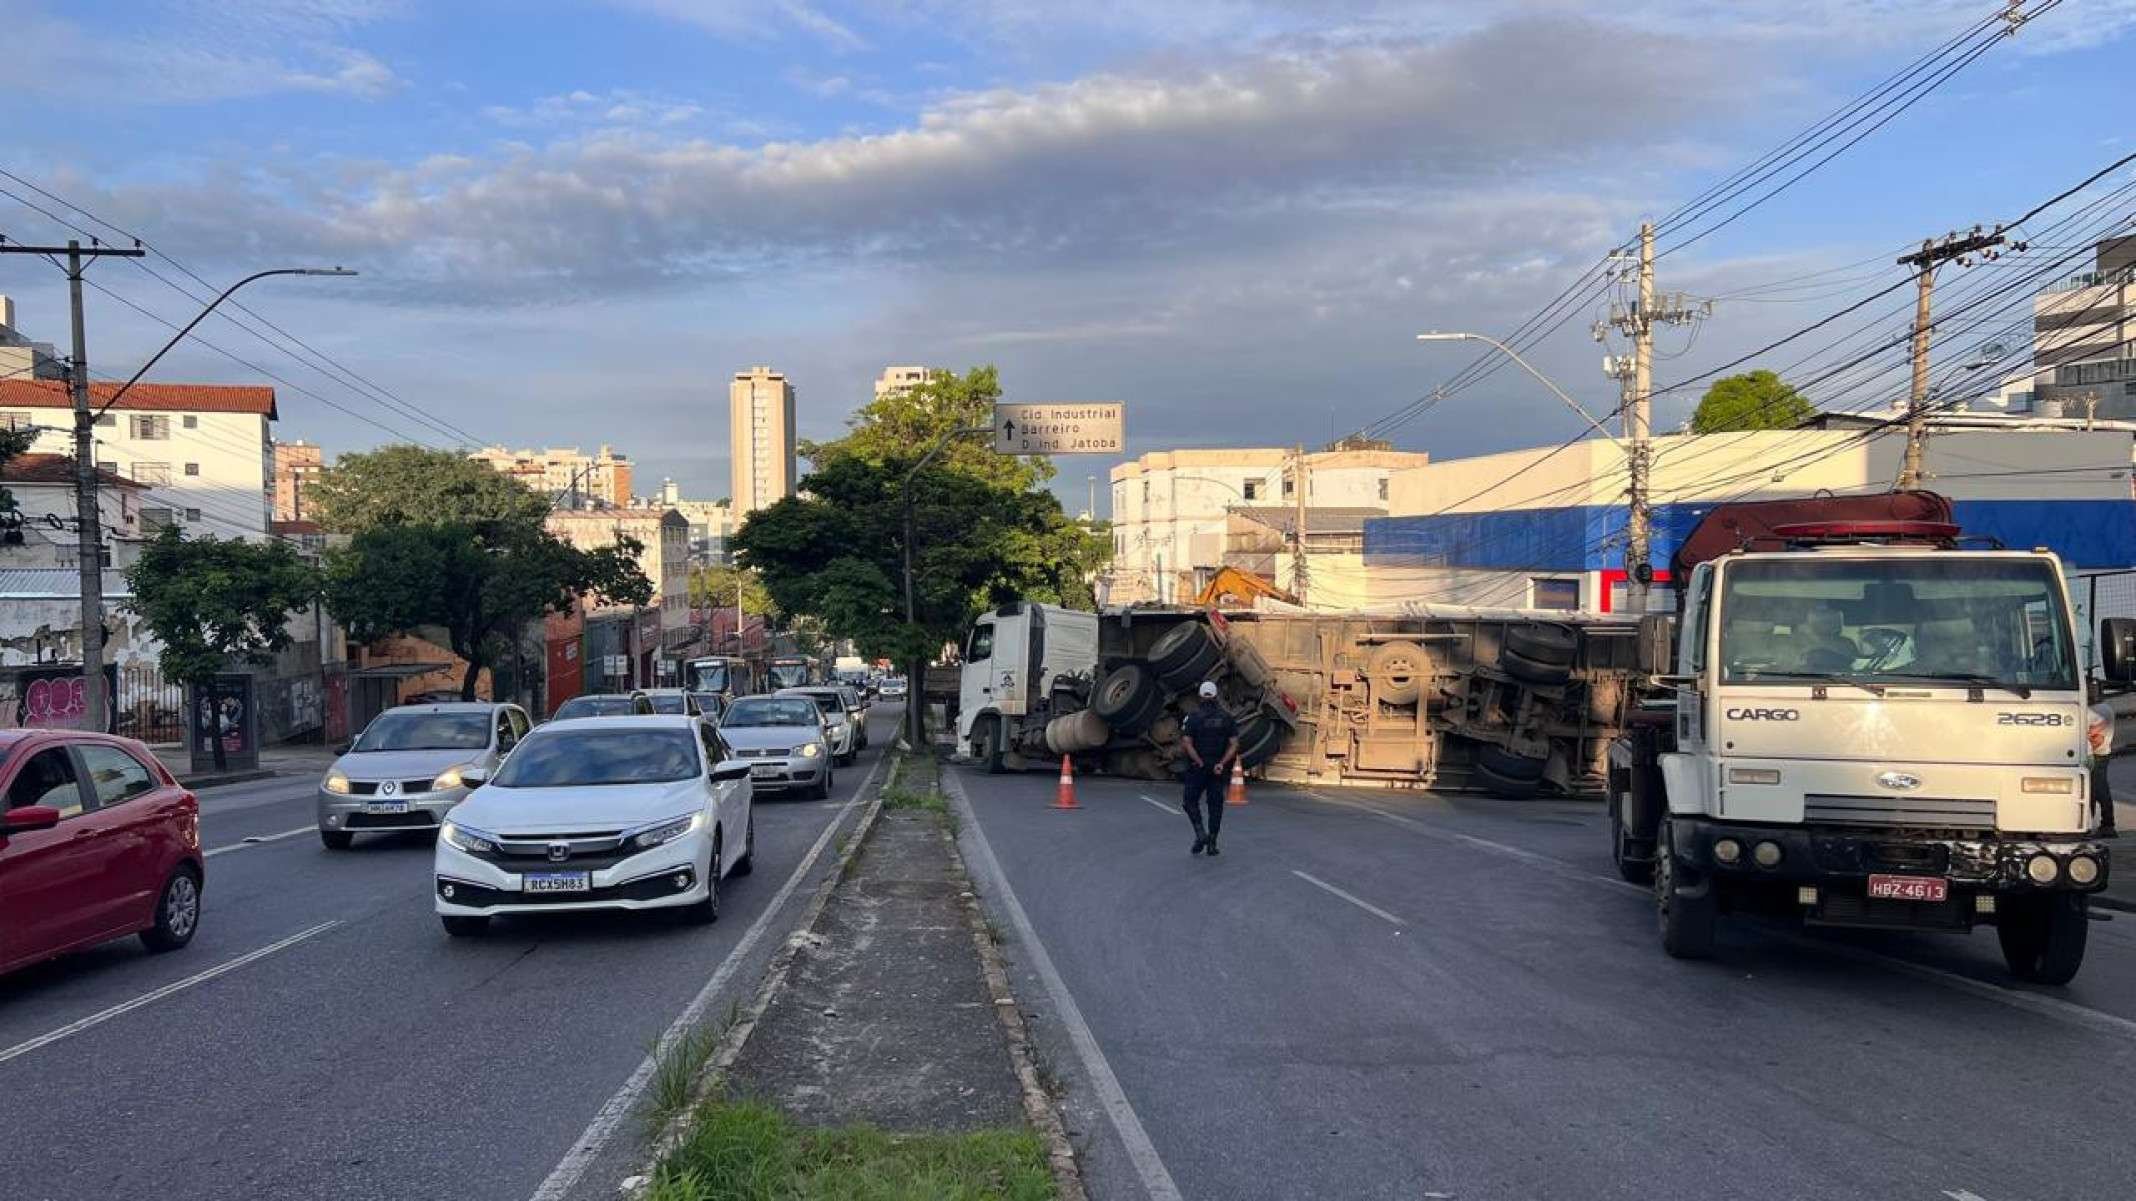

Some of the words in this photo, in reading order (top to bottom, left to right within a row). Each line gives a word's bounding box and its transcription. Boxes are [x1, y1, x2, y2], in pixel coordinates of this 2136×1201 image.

[1050, 408, 1116, 419] Industrial
[1021, 424, 1080, 435] Barreiro
[1039, 439, 1059, 449] Ind
[1726, 708, 1800, 721] CARGO
